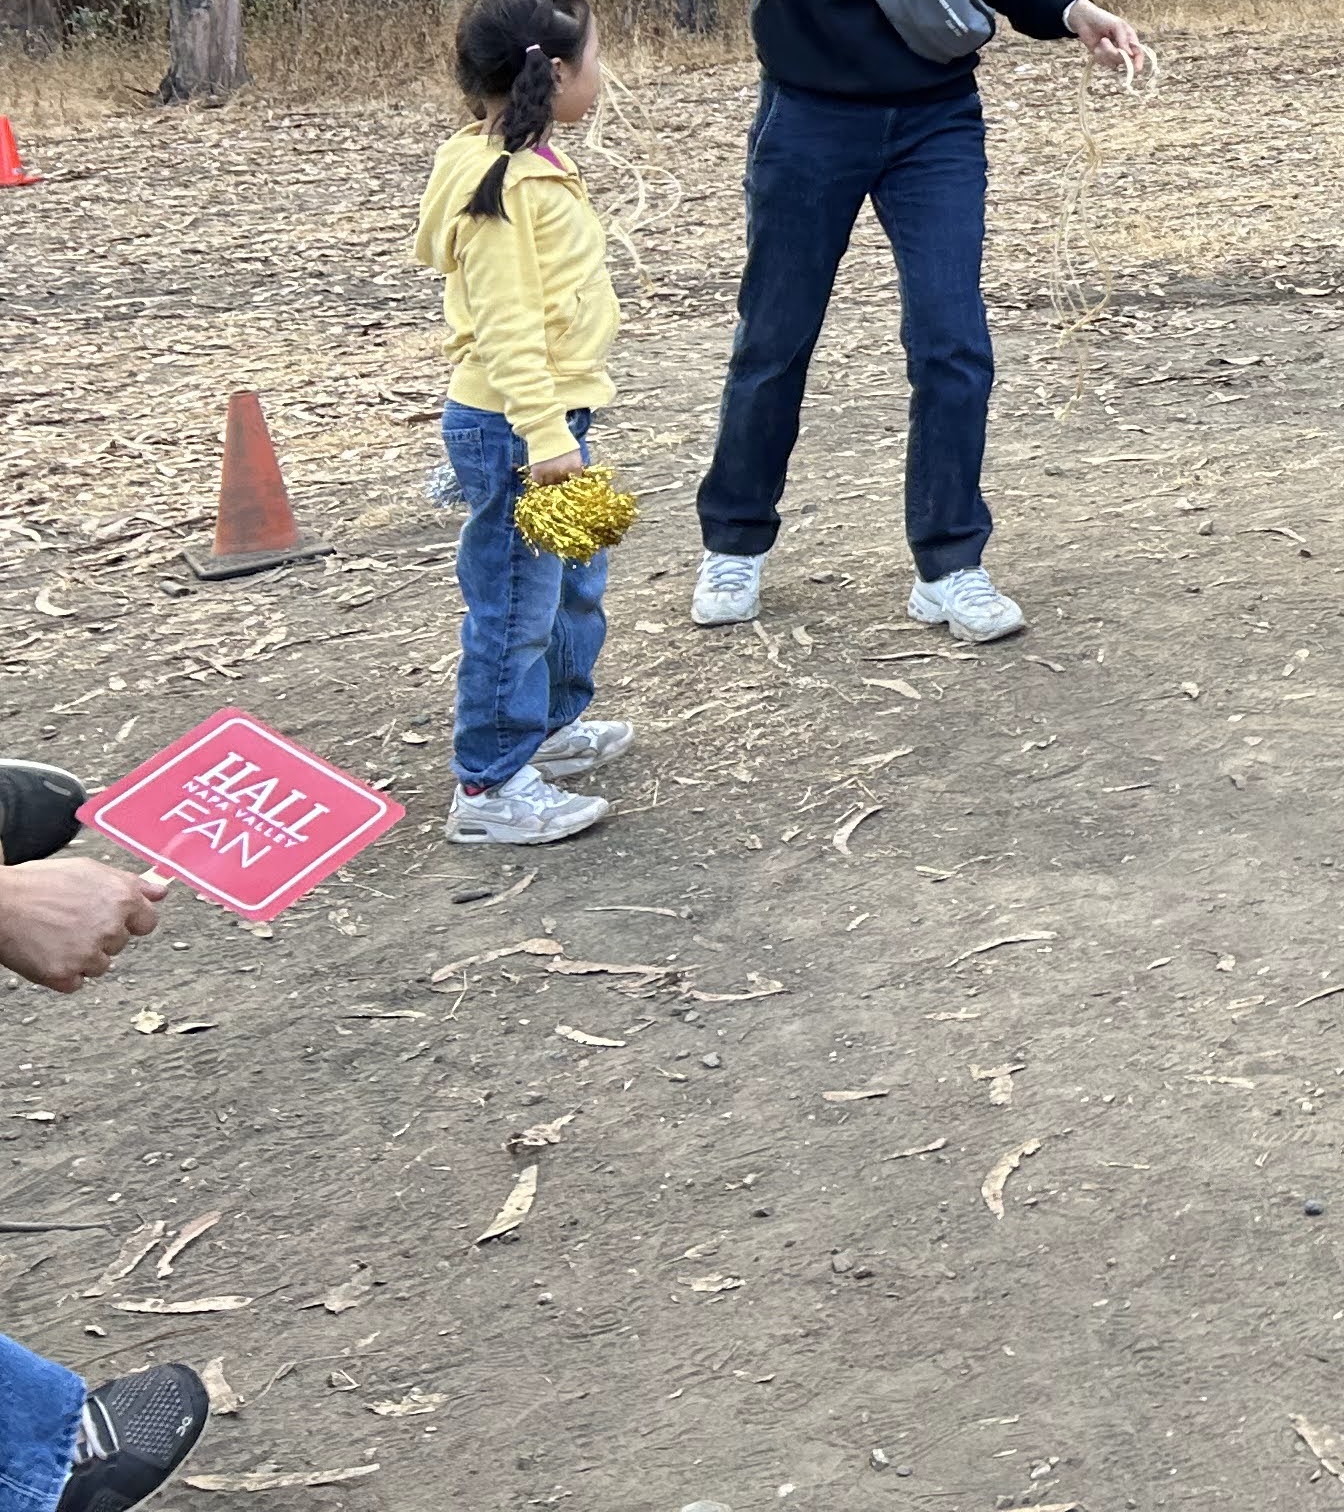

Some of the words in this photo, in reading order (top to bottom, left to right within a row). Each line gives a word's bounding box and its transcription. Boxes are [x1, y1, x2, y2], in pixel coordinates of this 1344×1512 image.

[182, 781, 230, 811] NAPA
[234, 809, 299, 848] VALLEY
[193, 751, 331, 843] HALL
[159, 798, 272, 869] FAN
